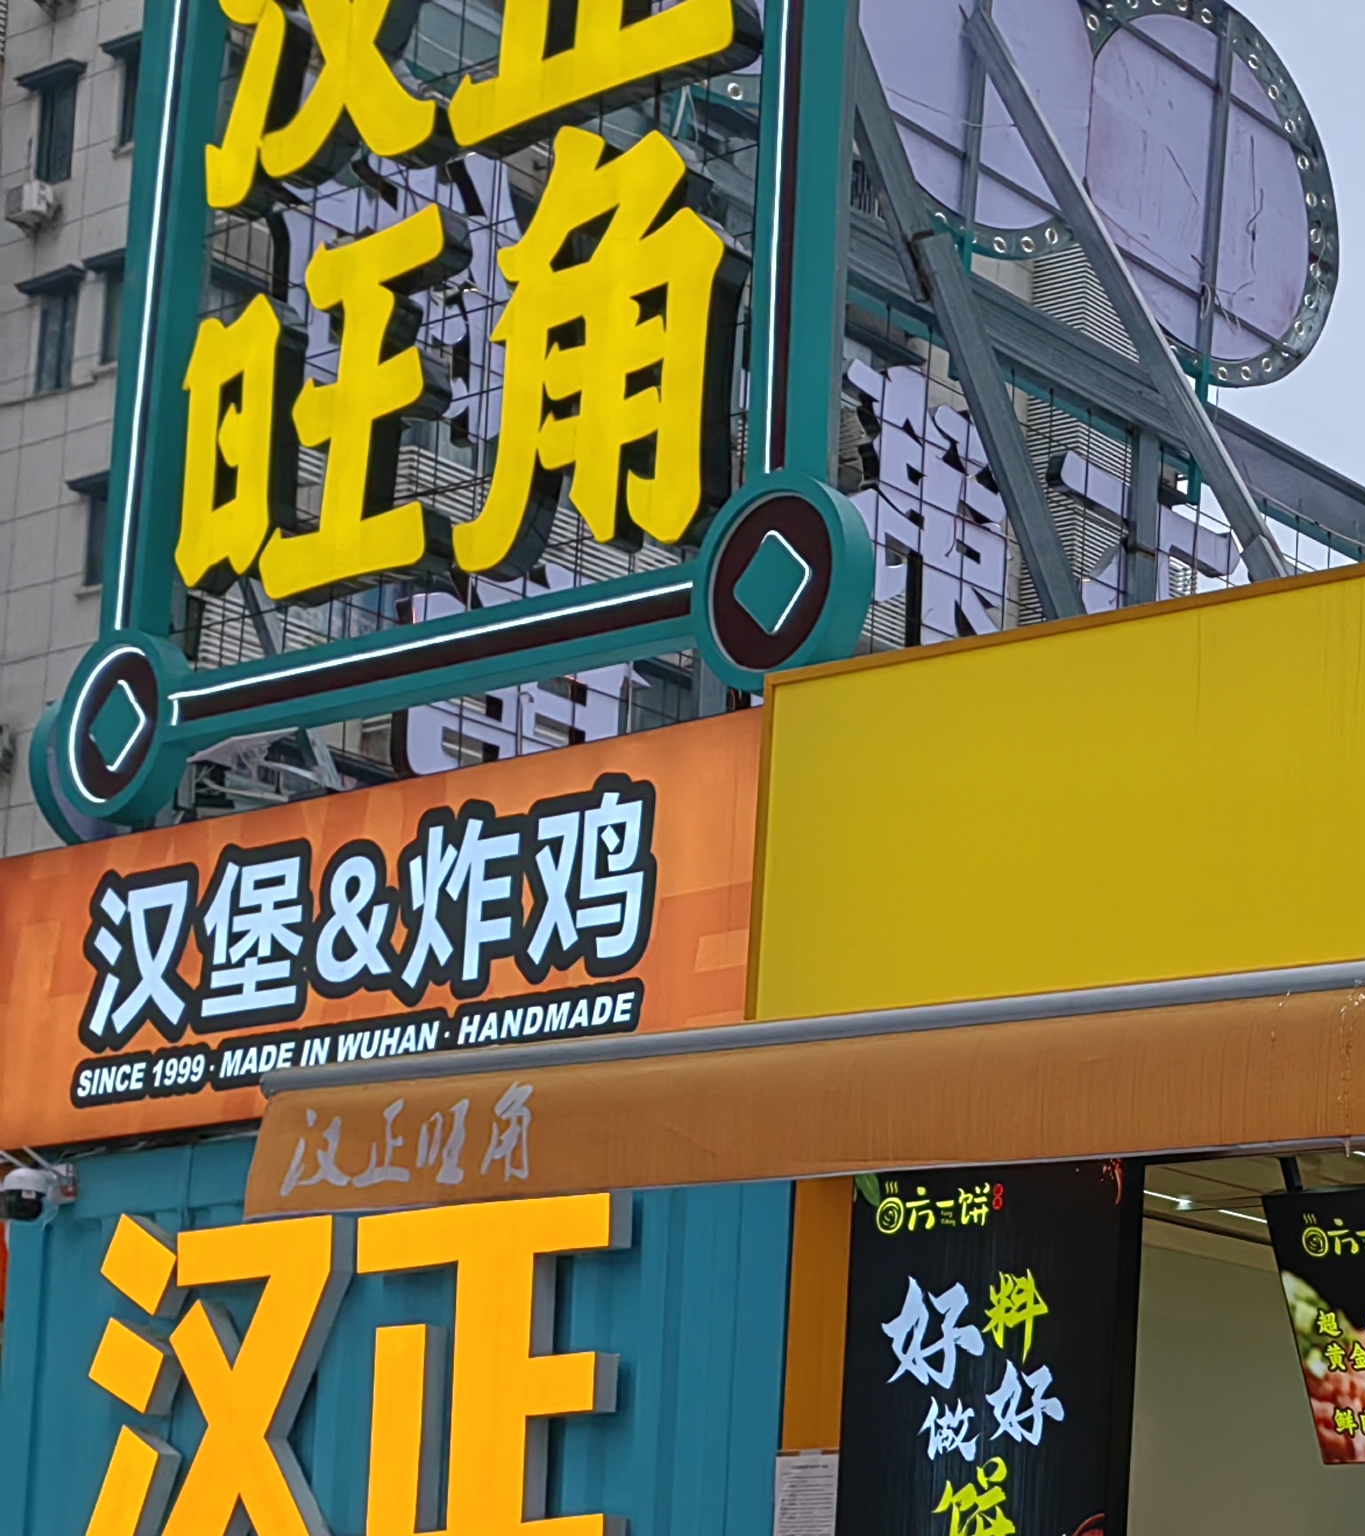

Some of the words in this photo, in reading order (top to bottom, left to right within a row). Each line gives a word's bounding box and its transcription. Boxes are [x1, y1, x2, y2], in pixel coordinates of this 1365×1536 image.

[174, 126, 724, 600] 旺角
[88, 792, 645, 1038] 汉堡&炸鸡
[77, 1061, 145, 1098] SINCE
[150, 1053, 204, 1088] 1999
[219, 1041, 295, 1078] MADE
[301, 1036, 328, 1066] IN
[336, 1021, 440, 1062] WUHAN
[457, 992, 634, 1044] HANDMADE
[280, 1082, 534, 1197] 汉正旺角
